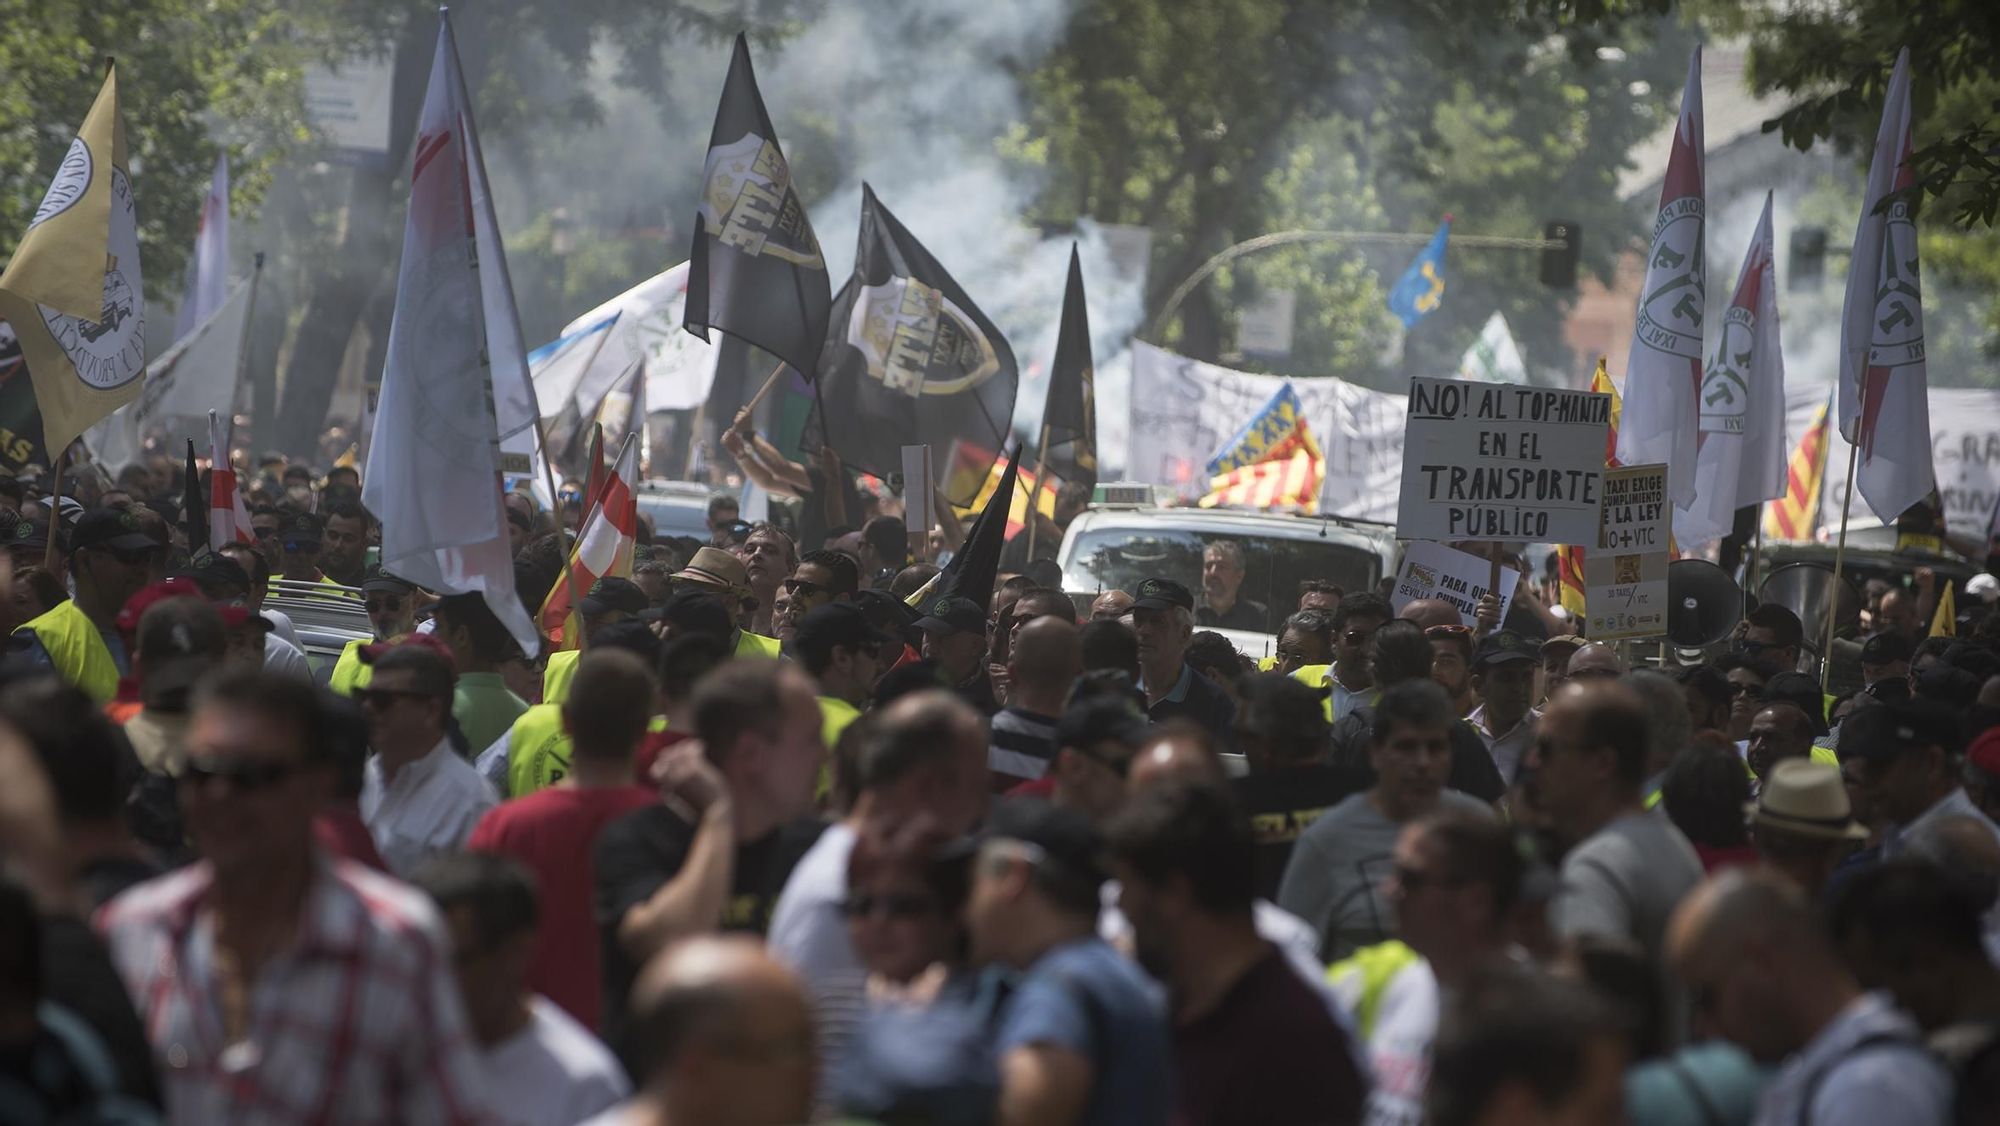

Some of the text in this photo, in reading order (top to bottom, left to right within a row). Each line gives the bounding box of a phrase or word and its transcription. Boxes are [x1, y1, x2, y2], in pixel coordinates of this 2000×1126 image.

[1478, 389, 1507, 420] AL
[1516, 390, 1610, 423] TOP-MANTA
[1479, 431, 1542, 460] EN EL
[1421, 465, 1599, 505] TRANSPORTE
[1606, 475, 1662, 495] TAXI EXIGE
[1615, 506, 1633, 524] LA
[1638, 502, 1663, 521] LEY
[1440, 574, 1469, 595] PARA
